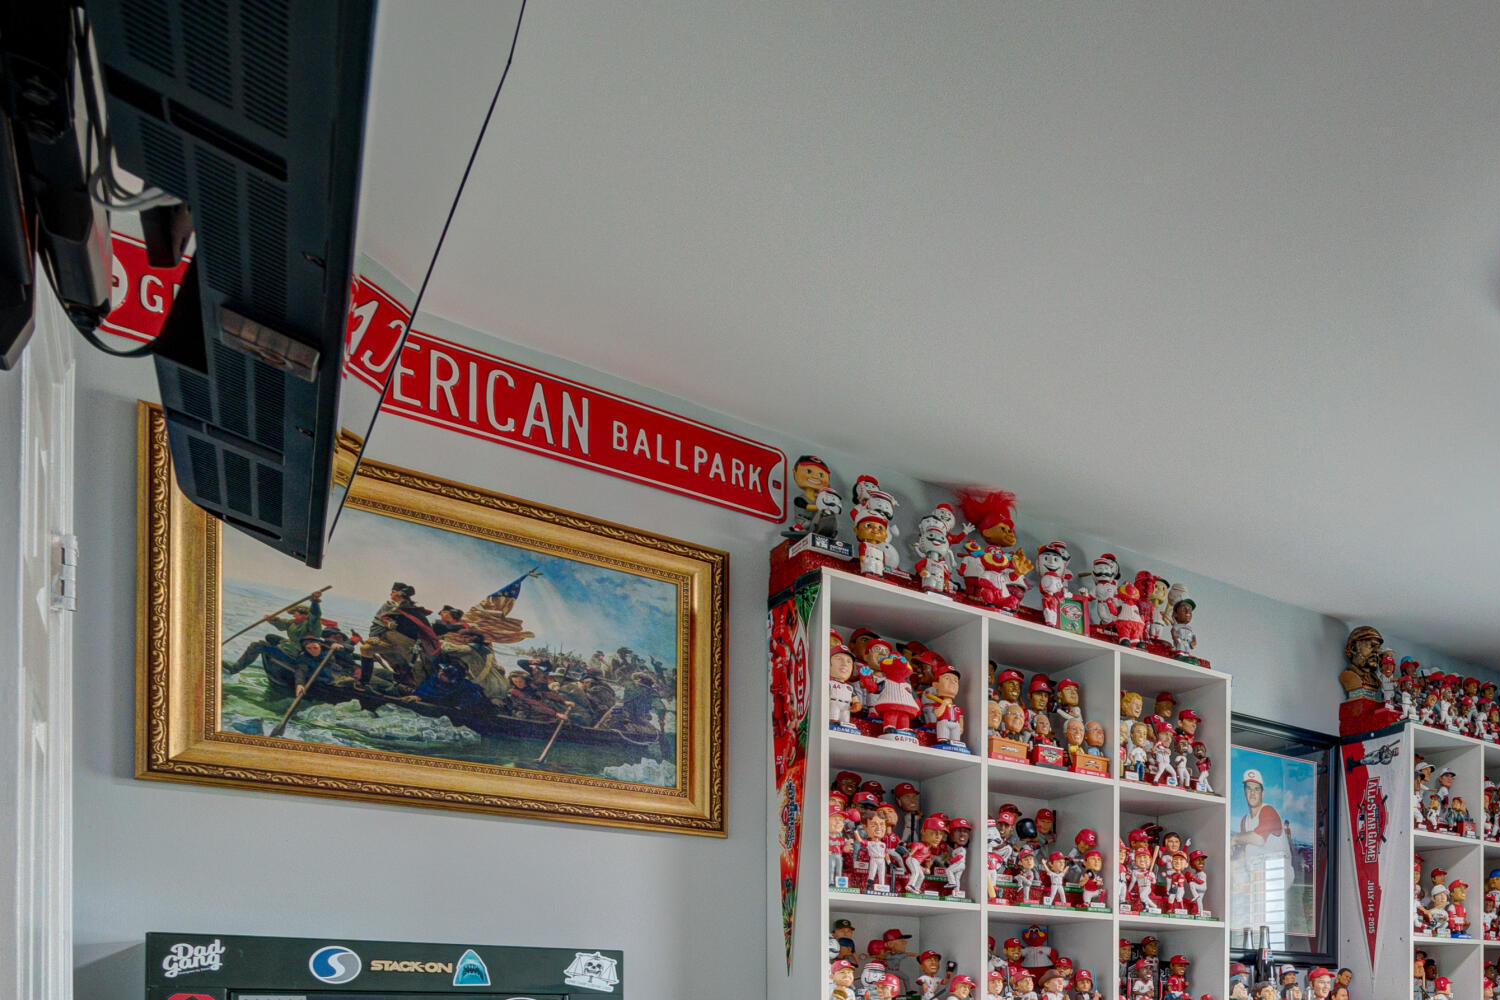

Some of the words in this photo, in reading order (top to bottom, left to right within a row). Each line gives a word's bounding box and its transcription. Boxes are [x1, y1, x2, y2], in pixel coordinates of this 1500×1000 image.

[390, 341, 589, 456] ERICAN
[611, 419, 763, 494] BALLPARK
[1366, 832, 1378, 861] GAME
[1367, 880, 1375, 900] JULY
[1367, 917, 1375, 935] 2015
[170, 938, 227, 960] Dad
[161, 953, 225, 979] Gang
[370, 959, 454, 975] STACK-ON
